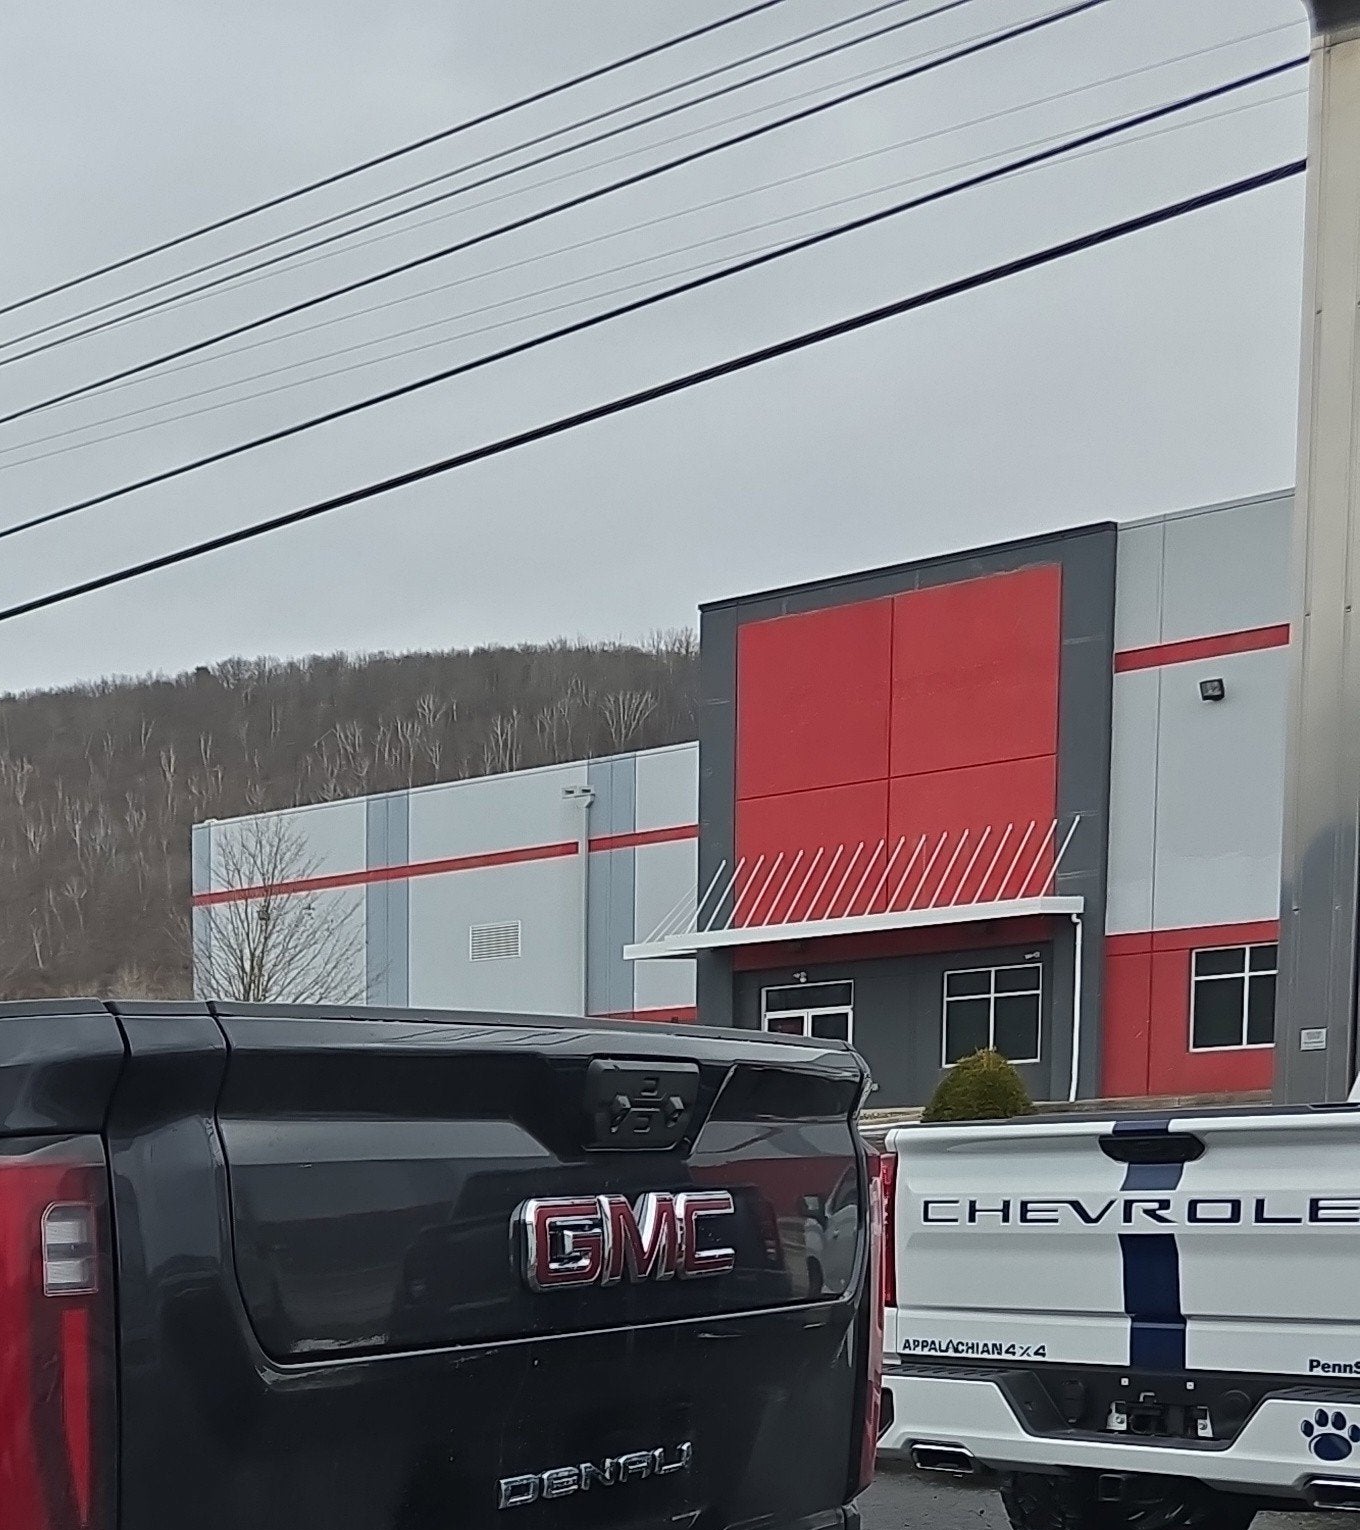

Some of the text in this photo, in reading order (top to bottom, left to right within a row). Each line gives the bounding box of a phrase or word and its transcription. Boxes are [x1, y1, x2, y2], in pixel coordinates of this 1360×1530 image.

[922, 1197, 1360, 1224] CHEVROLE
[509, 1191, 735, 1292] GMC
[902, 1339, 1002, 1355] APPALACHIAN
[498, 1442, 692, 1509] DENALI
